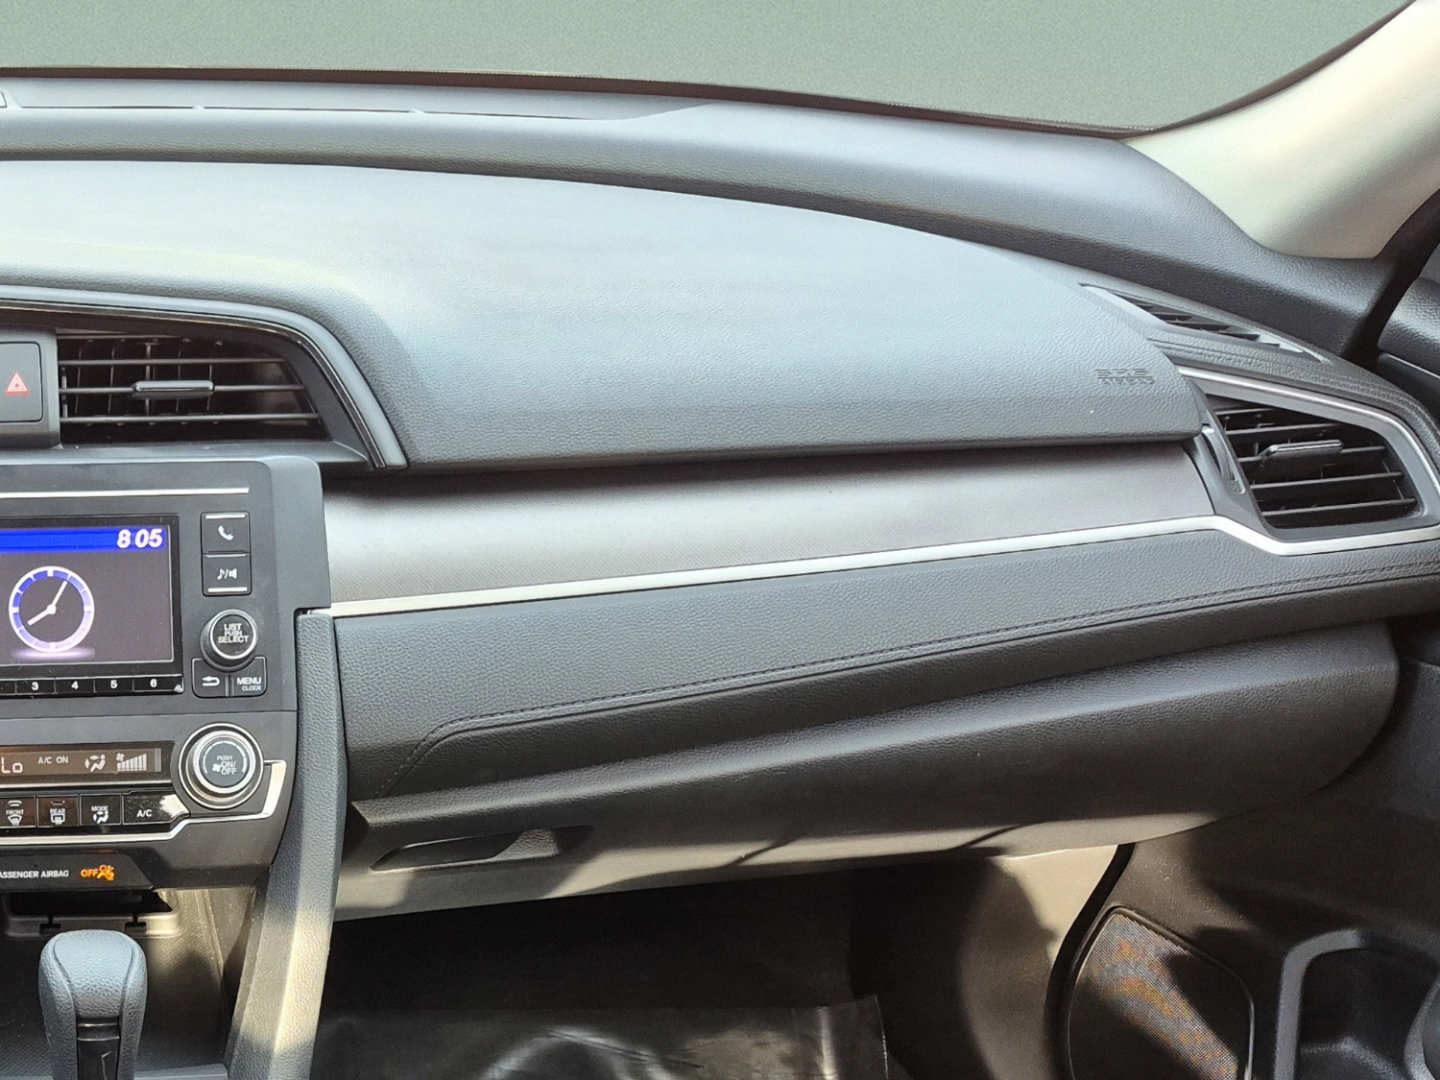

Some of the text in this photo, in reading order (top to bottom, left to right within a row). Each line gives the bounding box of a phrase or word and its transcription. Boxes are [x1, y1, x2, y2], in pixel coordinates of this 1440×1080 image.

[223, 623, 242, 631] LIST
[217, 635, 249, 644] SELECT
[31, 681, 39, 690] 3
[71, 680, 79, 690] 4
[110, 679, 118, 688] 5
[149, 678, 158, 688] 6
[236, 677, 262, 685] MENU
[1, 756, 23, 773] Lo
[220, 761, 237, 769] ON/
[220, 767, 237, 775] OFF
[136, 809, 153, 817] A/C
[41, 870, 69, 878] AIRBAG
[80, 869, 98, 877] OFF
